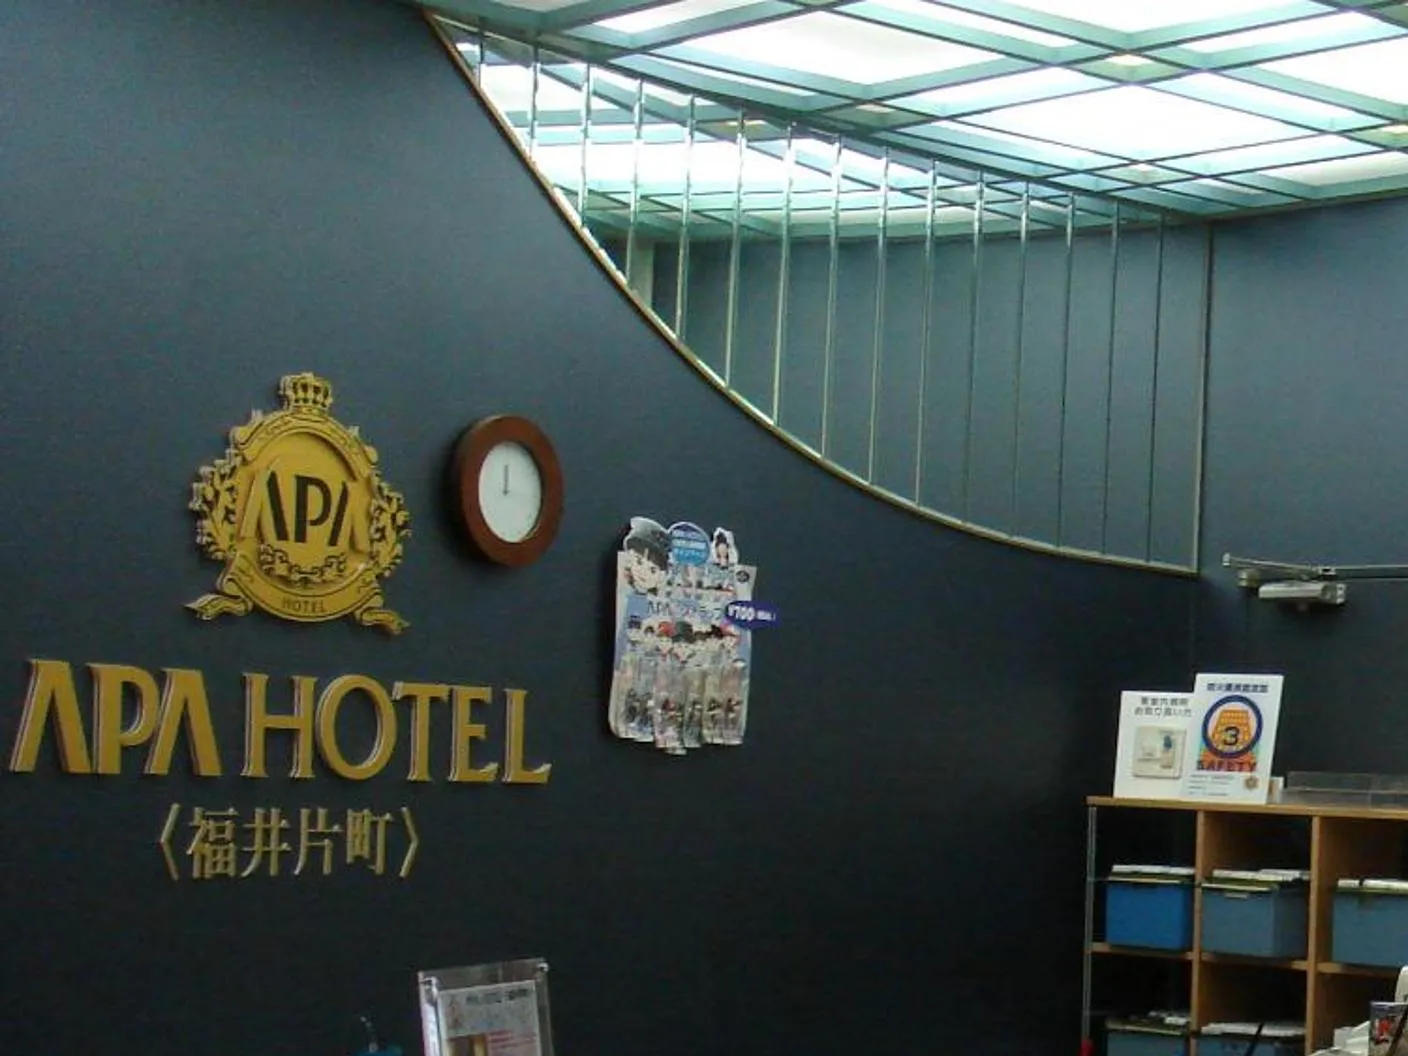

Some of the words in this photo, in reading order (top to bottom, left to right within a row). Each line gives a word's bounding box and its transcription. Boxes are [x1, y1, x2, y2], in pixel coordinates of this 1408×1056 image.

[250, 462, 366, 550] APA
[282, 596, 327, 613] HOTEL
[9, 659, 222, 775] APA
[240, 673, 552, 784] HOTEL
[1222, 725, 1241, 747] 3
[1196, 759, 1258, 772] SAFETY
